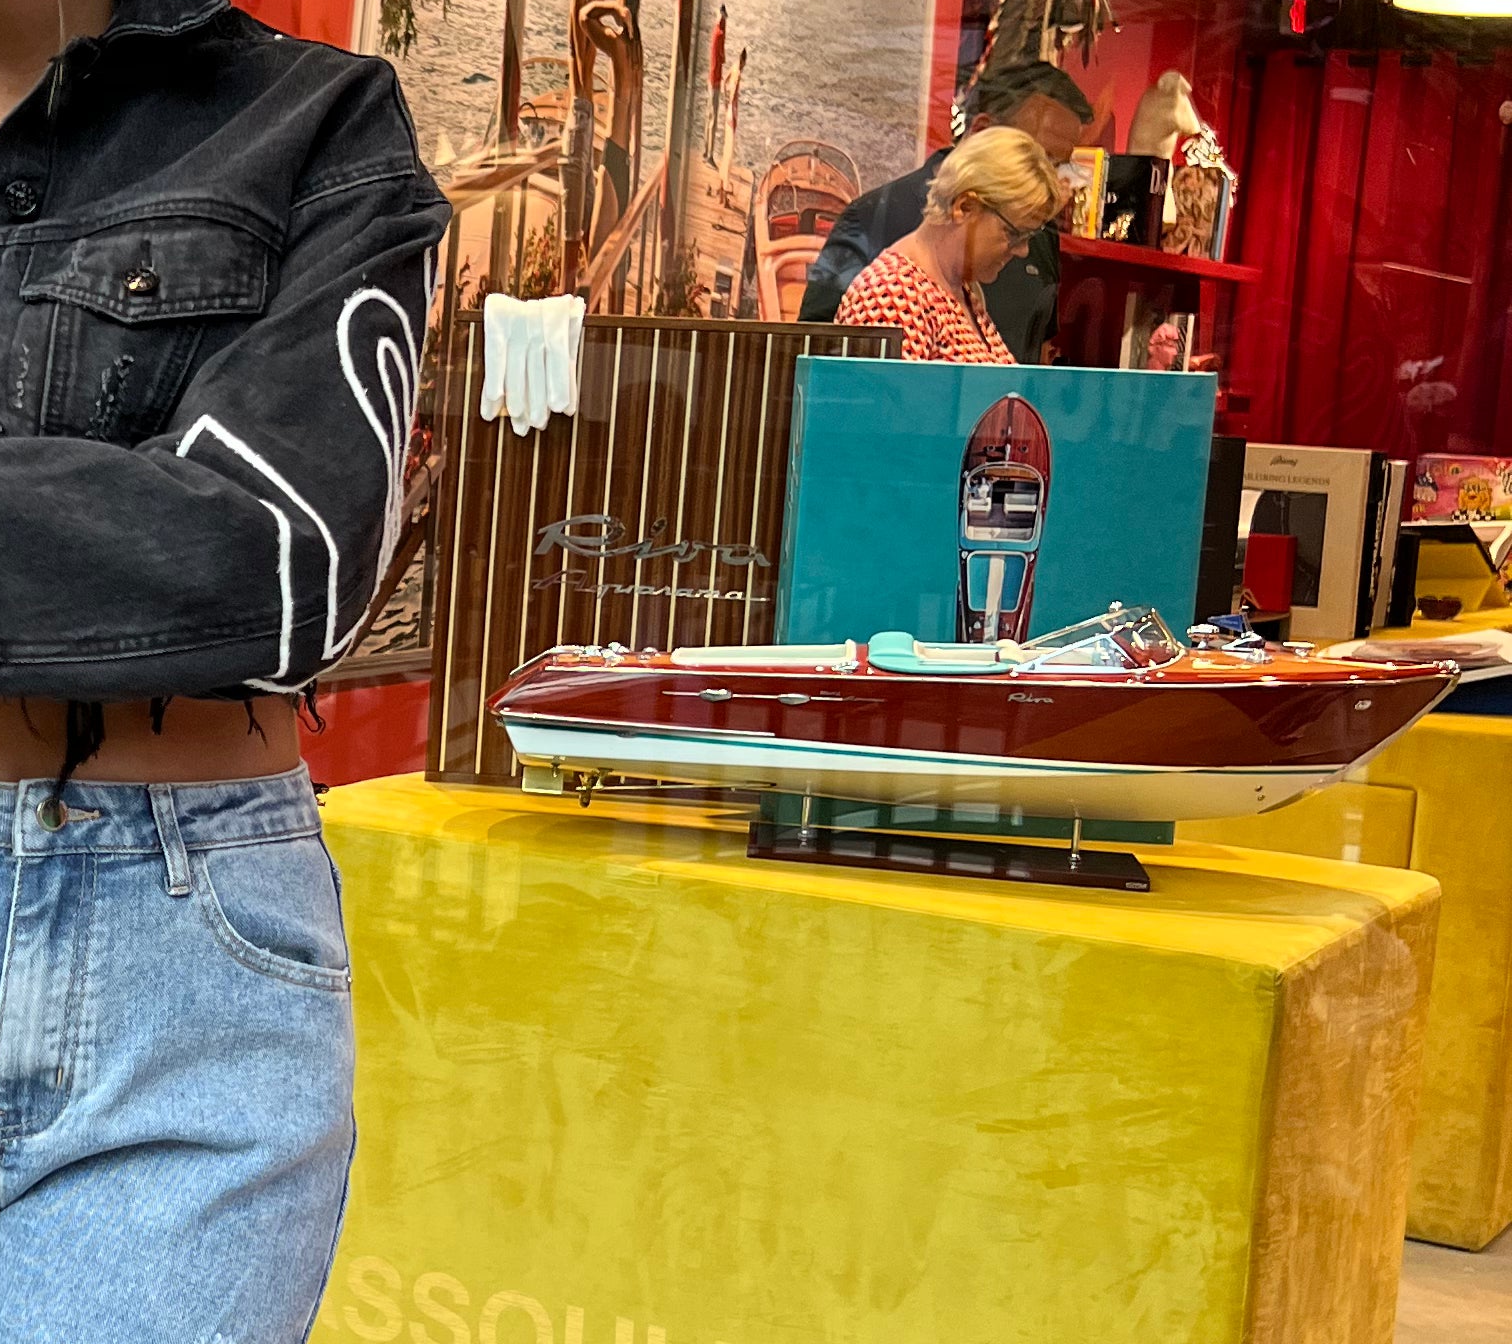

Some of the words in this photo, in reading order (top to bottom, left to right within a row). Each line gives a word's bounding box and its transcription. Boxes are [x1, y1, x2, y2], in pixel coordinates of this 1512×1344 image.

[534, 513, 772, 568] Riva
[531, 568, 771, 602] Aquarama
[1007, 692, 1054, 704] Riva
